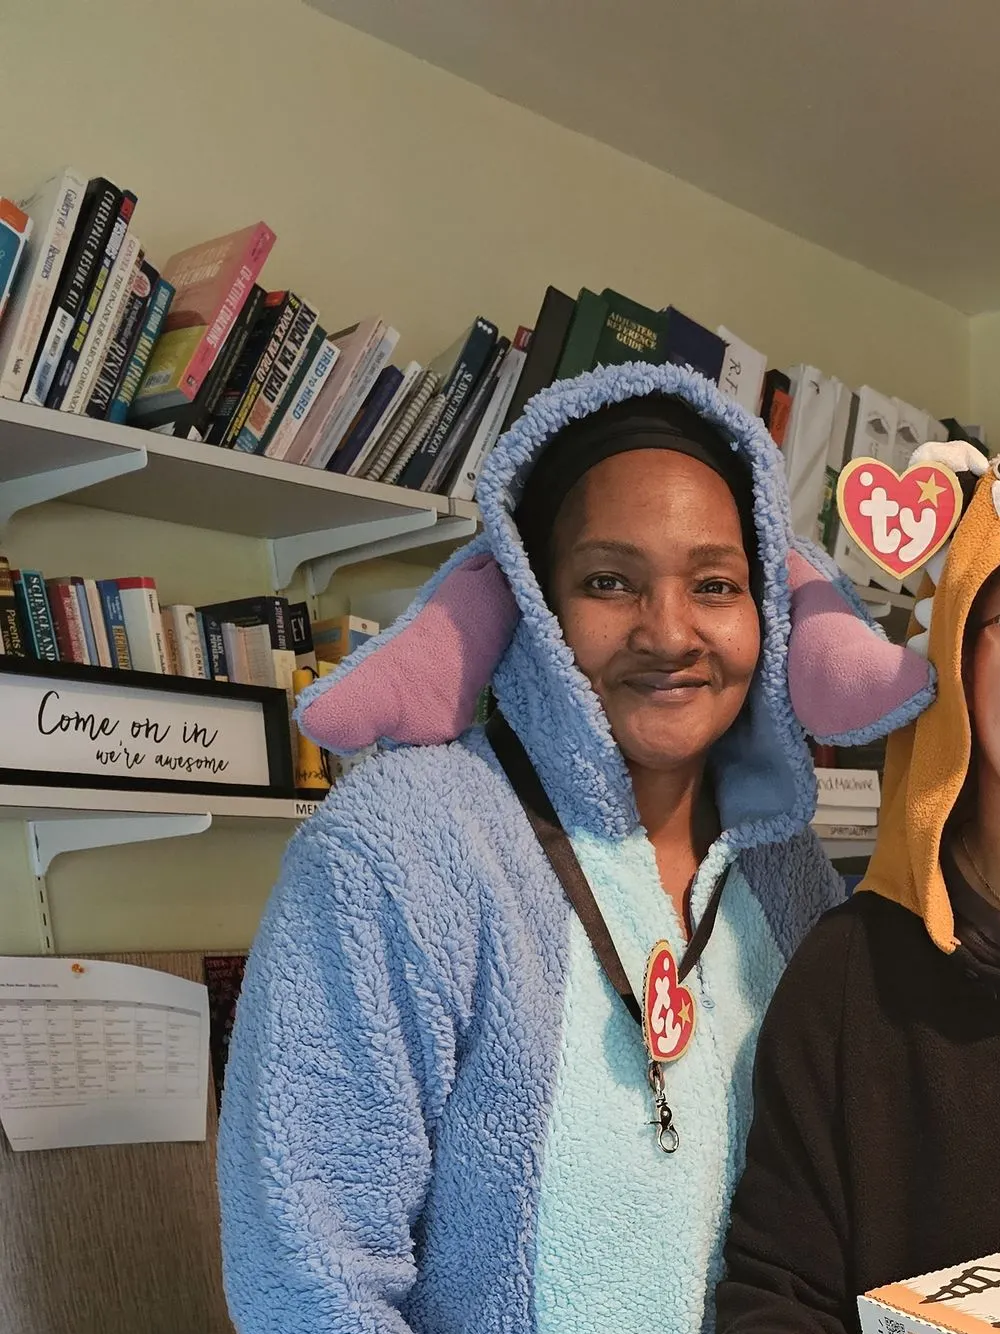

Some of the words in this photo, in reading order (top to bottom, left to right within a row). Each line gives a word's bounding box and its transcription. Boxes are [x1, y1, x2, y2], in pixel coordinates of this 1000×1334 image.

[59, 188, 77, 218] Gallery
[87, 190, 115, 250] CYBERSPACE
[41, 244, 60, 280] Resumes
[73, 250, 95, 289] RESUME
[67, 288, 80, 310] KIT
[114, 274, 124, 292] THE
[227, 265, 252, 309] CO-ACTIVE
[206, 303, 233, 348] COACHING
[275, 306, 294, 339] KNOCK
[291, 304, 317, 345] KNOCK
[606, 319, 656, 350] REFERENCE
[609, 312, 657, 341] ADJUSTERS
[86, 335, 102, 366] SEARCH
[134, 332, 154, 366] SMART
[616, 333, 643, 353] GUIDE
[91, 338, 127, 410] RESUMES
[256, 353, 273, 383] DEAD
[314, 346, 333, 378] FIRED
[68, 365, 92, 413] COMPANION
[119, 362, 141, 406] SPEAKING
[263, 365, 288, 403] DEAD
[454, 371, 473, 405] SLAYING
[293, 385, 313, 420] HIRED
[443, 403, 457, 424] THE
[429, 420, 450, 457] DRAGON
[859, 487, 936, 562] ty
[31, 576, 50, 628] SCIENCE
[43, 637, 56, 661] AND
[275, 605, 283, 628] STEPHEN
[217, 635, 225, 654] MARY
[38, 690, 120, 740] Come
[131, 722, 173, 744] on
[183, 721, 218, 747] in
[96, 740, 145, 769] we're
[155, 751, 230, 774] awesome
[651, 976, 682, 1054] ty
